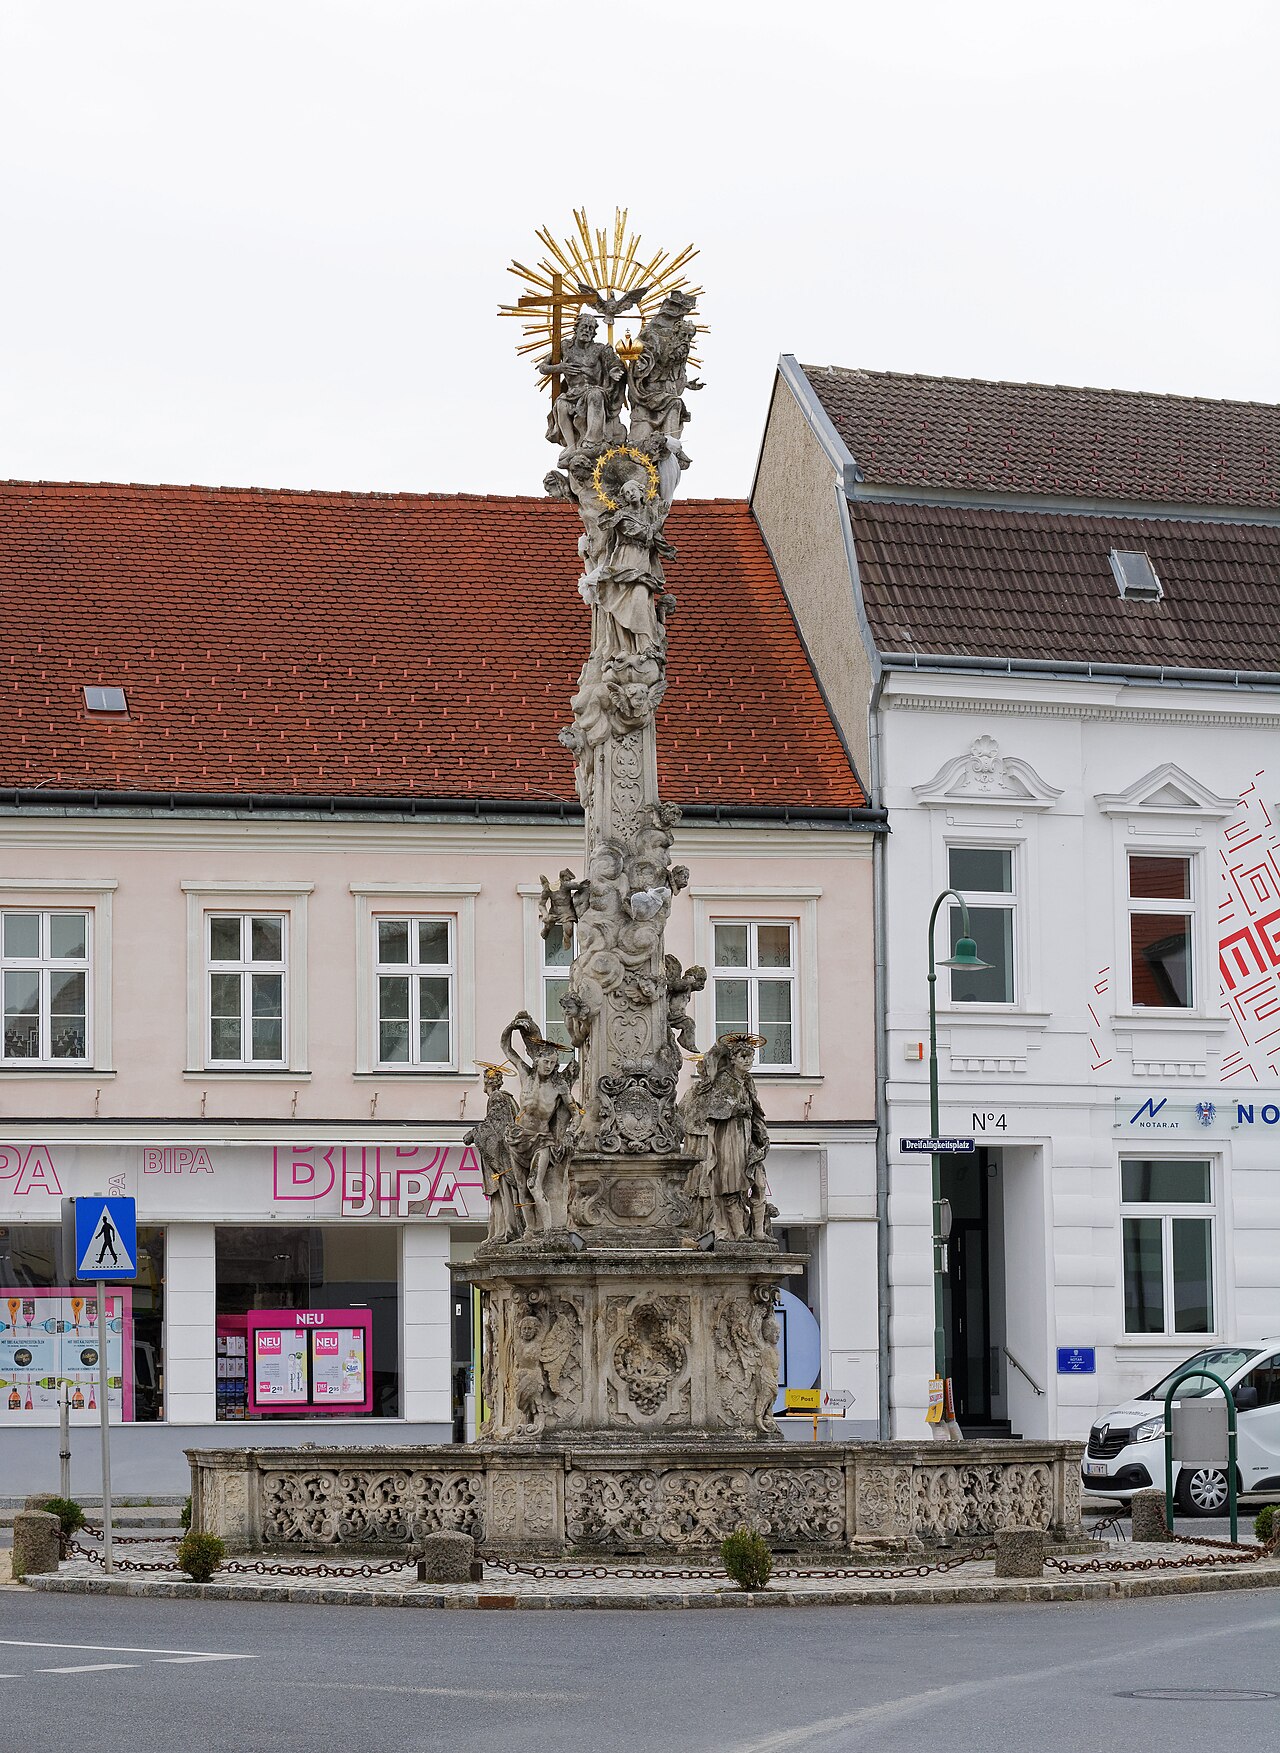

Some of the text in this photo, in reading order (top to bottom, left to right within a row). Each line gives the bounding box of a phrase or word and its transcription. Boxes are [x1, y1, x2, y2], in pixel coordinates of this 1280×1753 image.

[972, 1113, 1007, 1131] N°4
[906, 1140, 969, 1151] Dreifaltigkeitsplatz
[144, 1148, 214, 1174] BIPA
[342, 1172, 469, 1218] BIPA
[296, 1313, 324, 1325] NEU
[259, 1337, 280, 1347] NEU
[317, 1338, 338, 1347] NEU
